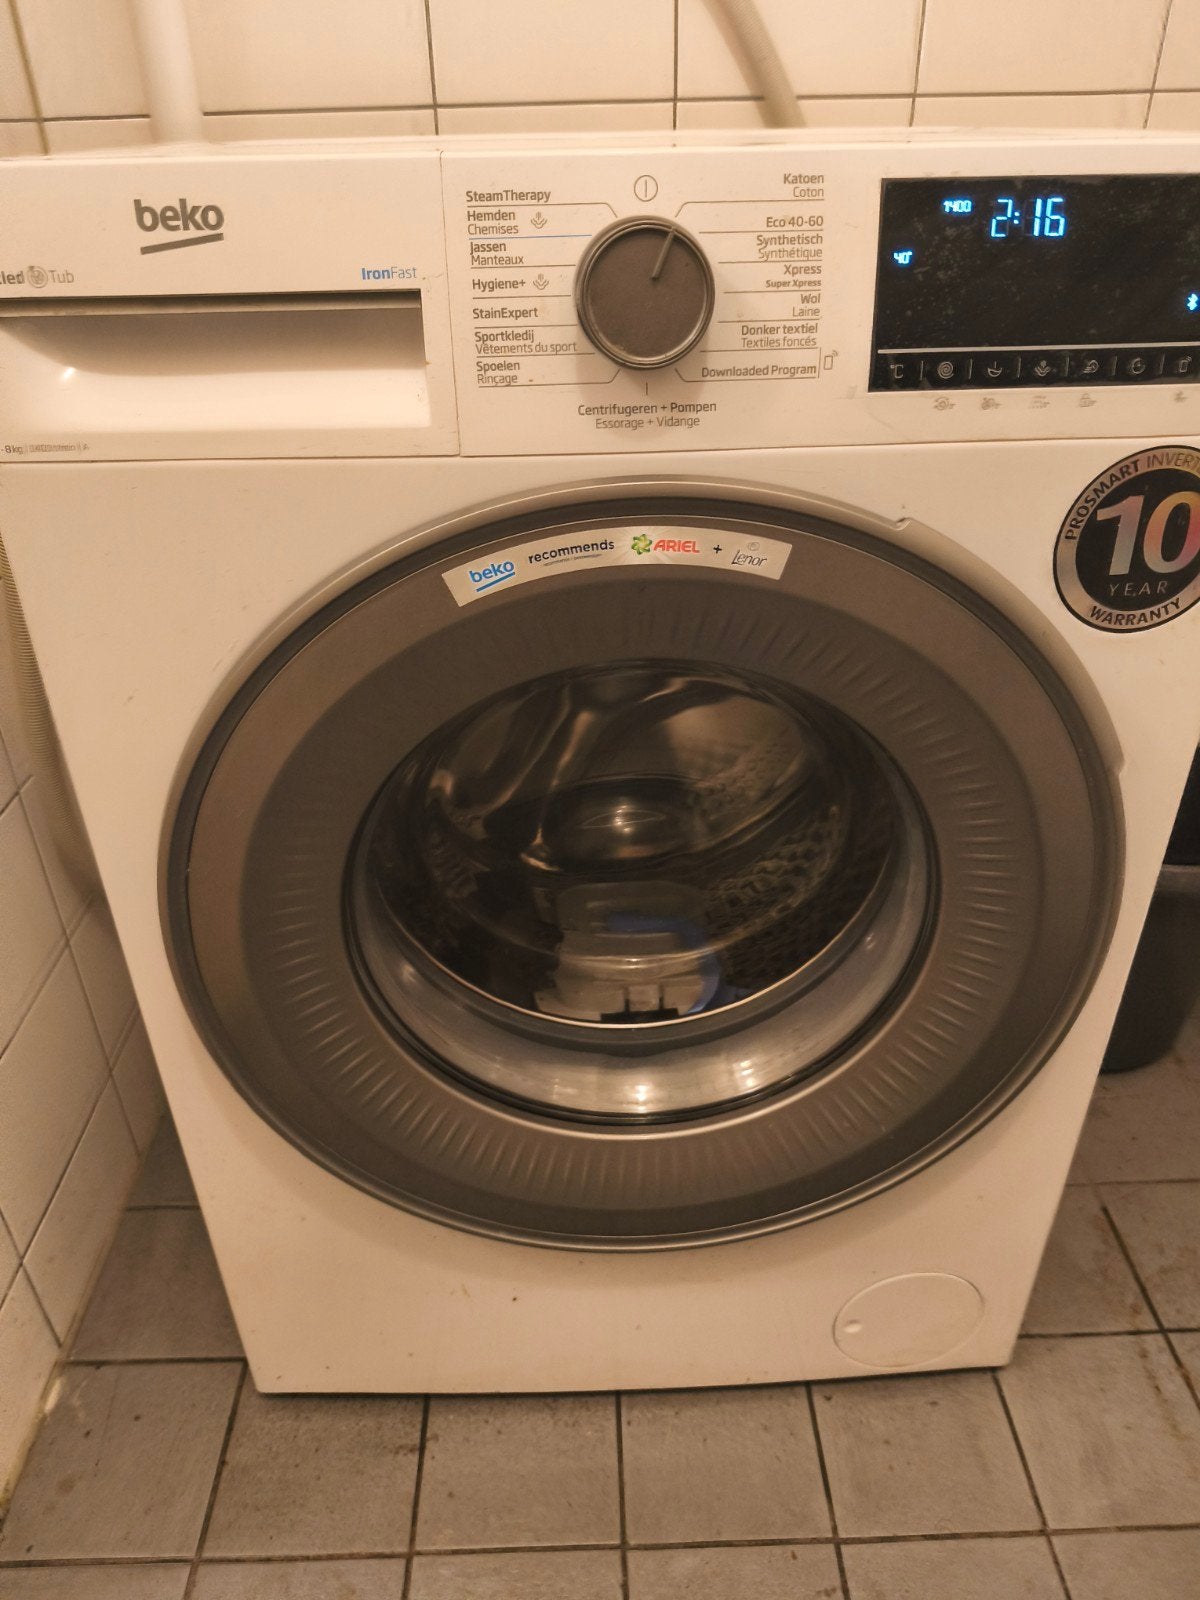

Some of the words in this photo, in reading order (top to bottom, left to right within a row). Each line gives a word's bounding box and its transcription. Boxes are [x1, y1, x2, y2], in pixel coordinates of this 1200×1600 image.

[783, 173, 825, 185] Katoen
[466, 189, 552, 203] SteamTherapy
[793, 186, 825, 198] Coton
[943, 200, 973, 213] 1400
[134, 198, 225, 232] beko
[467, 210, 516, 222] Hemden
[766, 216, 785, 228] Eco
[788, 215, 824, 228] 40-60
[990, 197, 1067, 238] 2:16
[467, 223, 519, 235] Chemises
[756, 233, 823, 247] Synthetisch
[470, 242, 507, 255] Jassen
[758, 246, 823, 261] Synthétique
[471, 254, 524, 266] Manteaux
[0, 270, 25, 285] led
[48, 269, 75, 284] Tub
[783, 264, 822, 278] Xpress
[472, 278, 526, 293] Hygiene+
[765, 279, 791, 290] Super
[792, 279, 822, 289] Xpress
[800, 294, 821, 305] Wol
[472, 307, 539, 321] StainExpert
[792, 306, 821, 318] Laine
[741, 324, 781, 336] Donker
[782, 323, 818, 334] textiel
[474, 330, 535, 344] Sportkledij
[741, 337, 781, 349] Textiles
[782, 336, 817, 348] foncés
[475, 342, 533, 355] Vêtements
[534, 342, 549, 353] du
[550, 341, 577, 355] sport
[476, 360, 520, 374] Spoelen
[701, 365, 769, 378] Downloaded
[771, 364, 817, 378] Program
[477, 374, 518, 387] Rinçage
[578, 403, 657, 417] Centrifugeren
[670, 402, 717, 414] Pompen
[596, 417, 644, 431] Essorage
[656, 415, 700, 428] Vidange
[1065, 460, 1140, 541] PROSMART
[1096, 490, 1200, 576] 10
[469, 558, 515, 584] beko
[528, 539, 615, 564] recommends
[653, 539, 700, 553] ARIEL
[731, 550, 768, 567] Lenor
[1109, 580, 1168, 596] YEAR
[1090, 597, 1181, 626] WARRANTY
